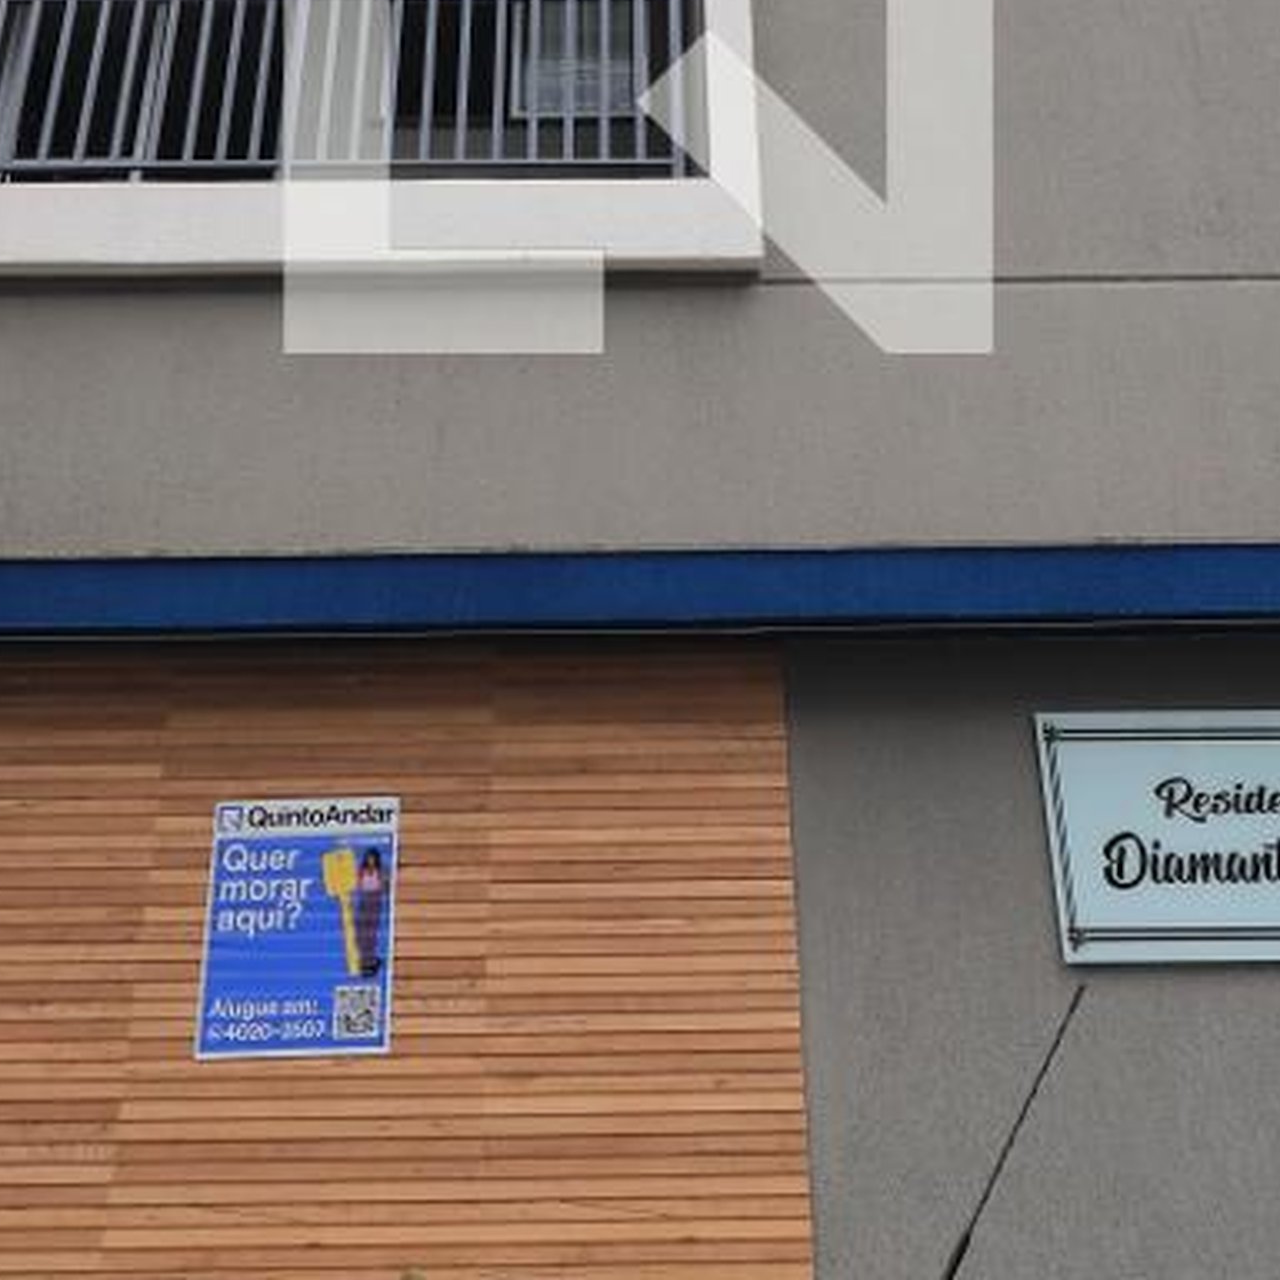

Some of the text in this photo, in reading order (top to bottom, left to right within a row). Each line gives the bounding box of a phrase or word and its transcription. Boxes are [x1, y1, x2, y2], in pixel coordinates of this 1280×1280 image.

[248, 804, 394, 829] QuintoAndar
[222, 843, 301, 873] Quer
[219, 878, 313, 901] morar
[216, 901, 303, 939] aqui?
[206, 997, 278, 1021] Alugue
